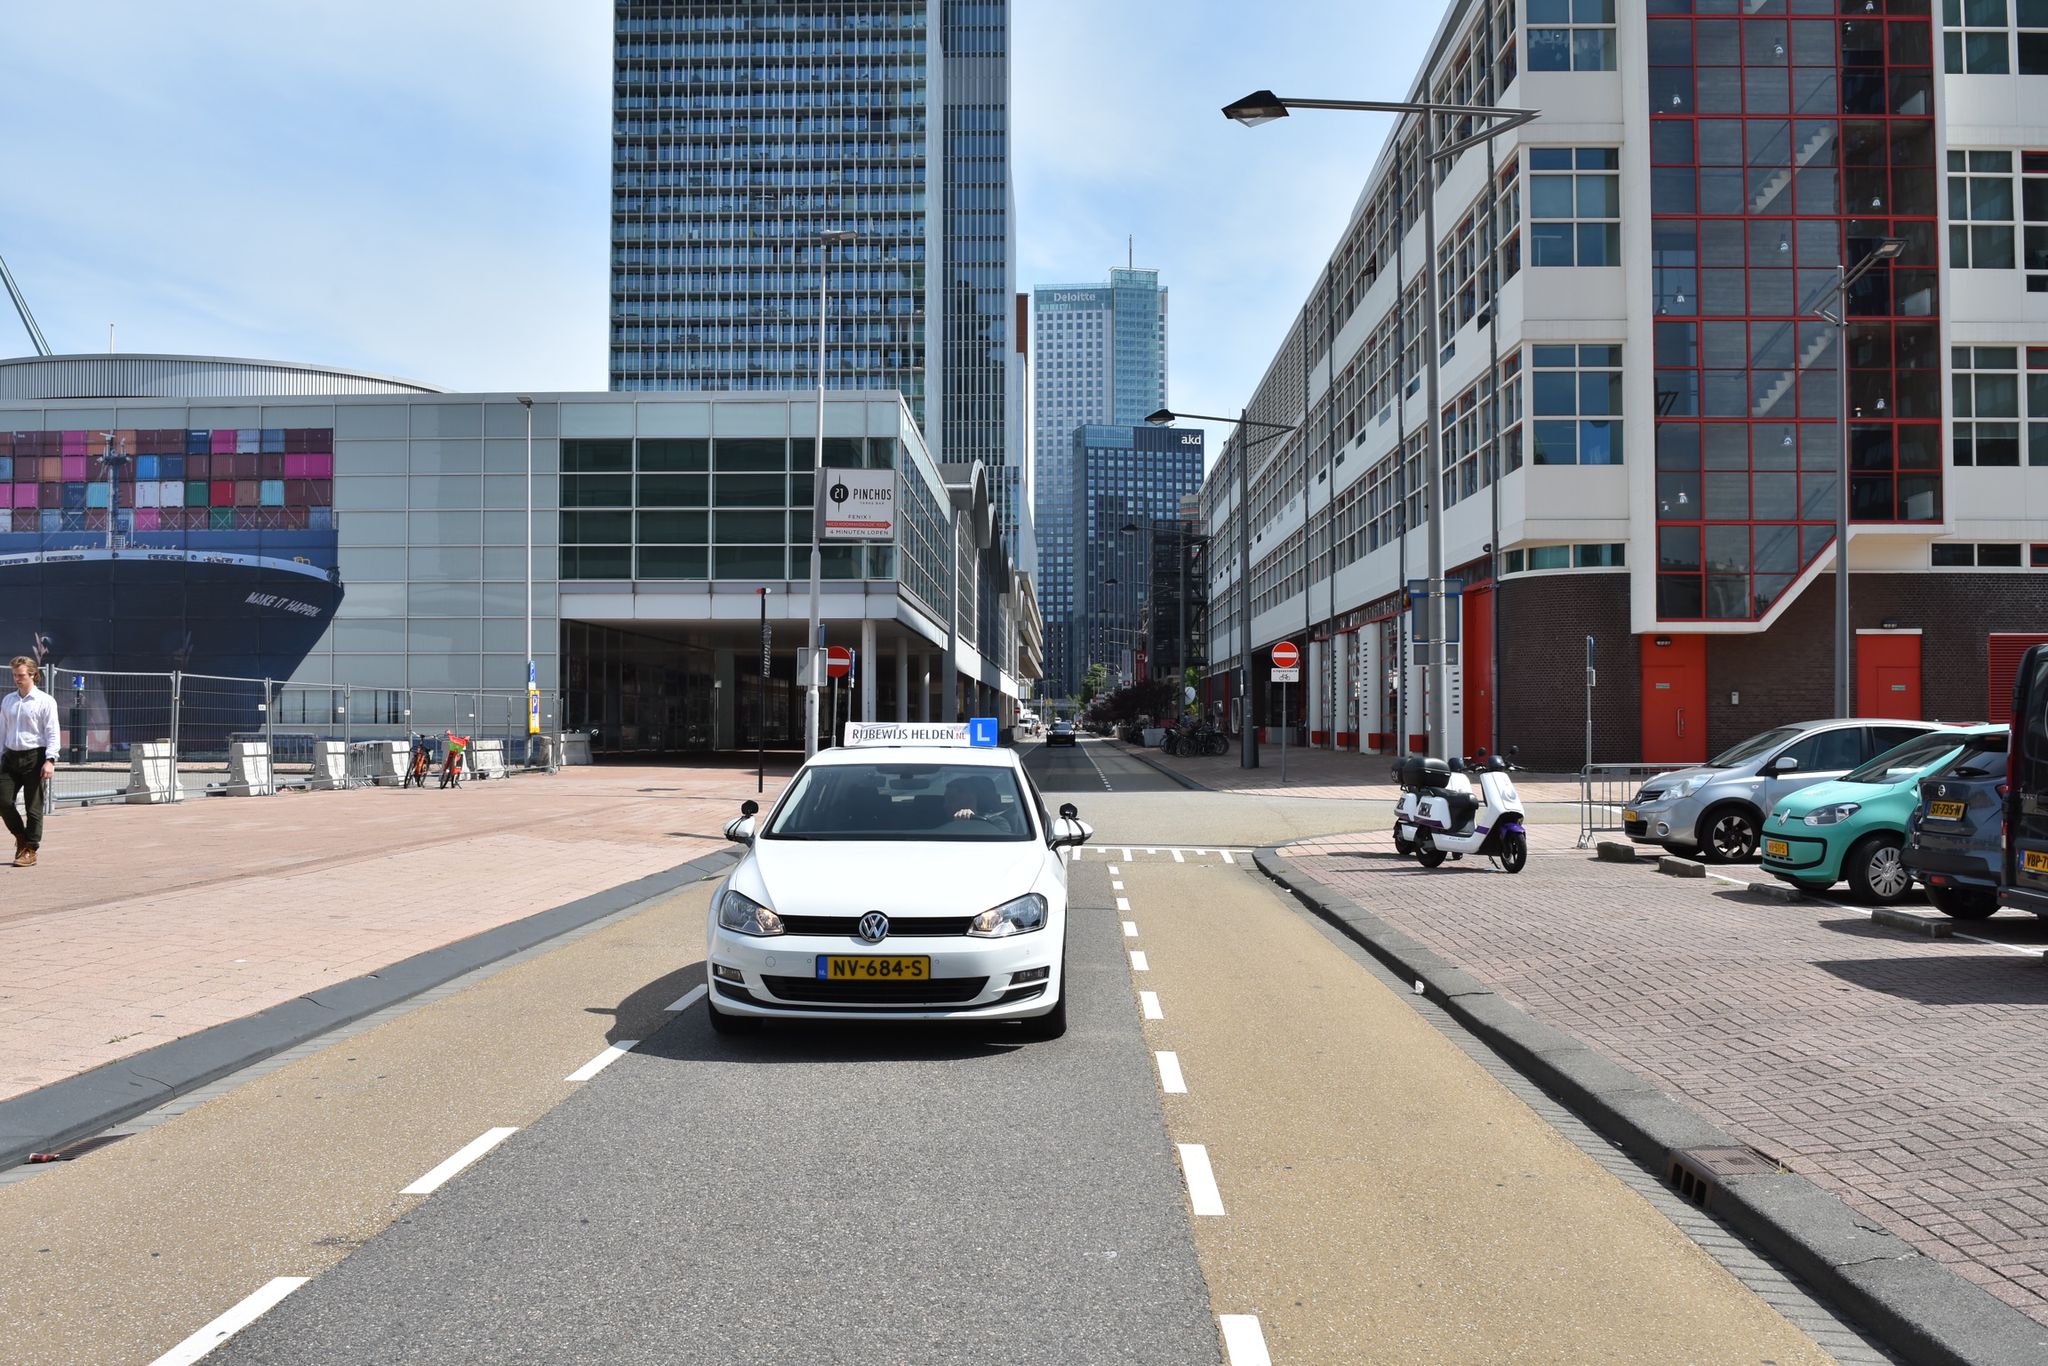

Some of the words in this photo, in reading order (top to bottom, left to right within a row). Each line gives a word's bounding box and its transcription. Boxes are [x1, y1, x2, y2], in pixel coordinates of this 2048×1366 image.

[1053, 291, 1096, 302] Deloitte
[1180, 434, 1202, 445] akd
[834, 487, 844, 499] 21
[853, 488, 892, 501] PINCHOS
[245, 591, 278, 607] MAKE
[273, 597, 290, 609] IT
[852, 728, 908, 740] RIJBEWIJS
[977, 723, 990, 742] L
[833, 959, 923, 977] NV-684-S
